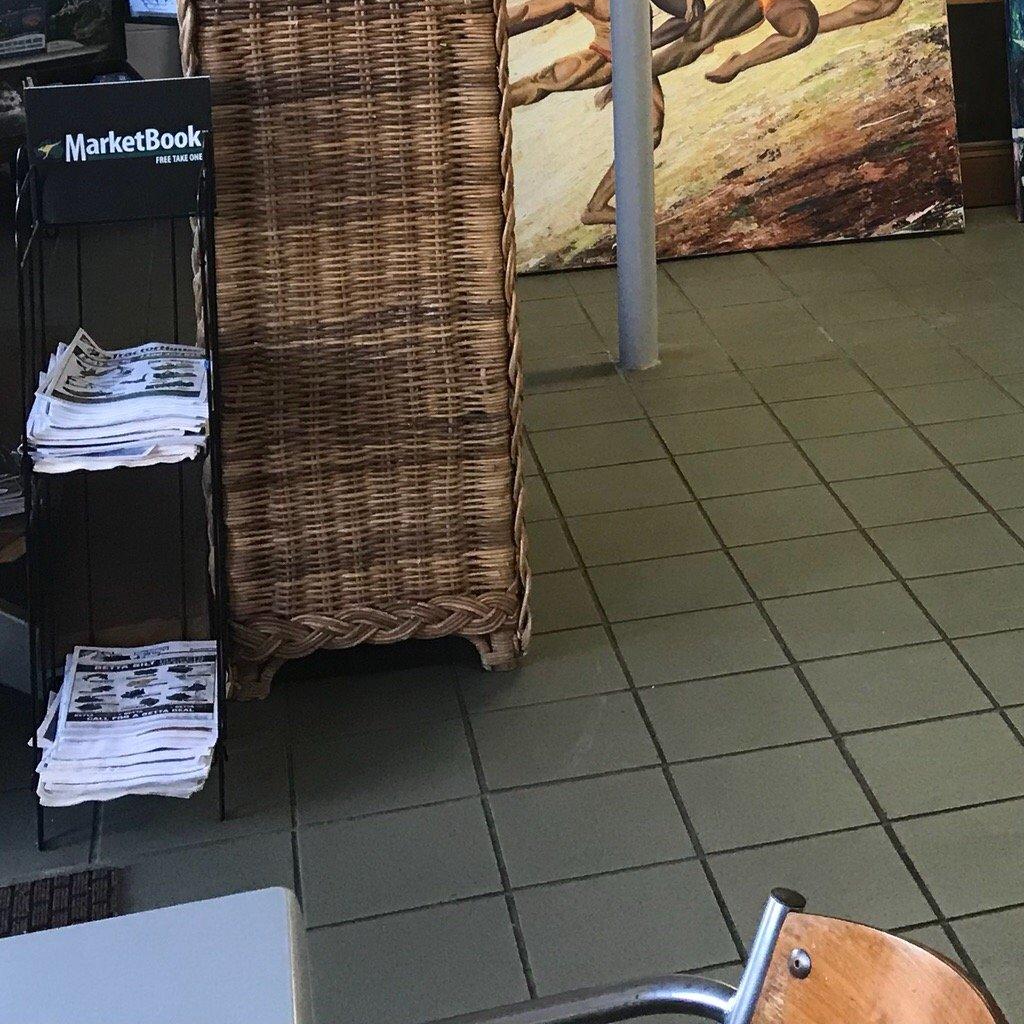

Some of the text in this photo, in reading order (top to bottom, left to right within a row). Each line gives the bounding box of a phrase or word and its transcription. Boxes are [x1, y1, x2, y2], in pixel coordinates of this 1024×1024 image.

[65, 124, 202, 163] MarketBook
[155, 152, 203, 165] FREE TAKE ONE
